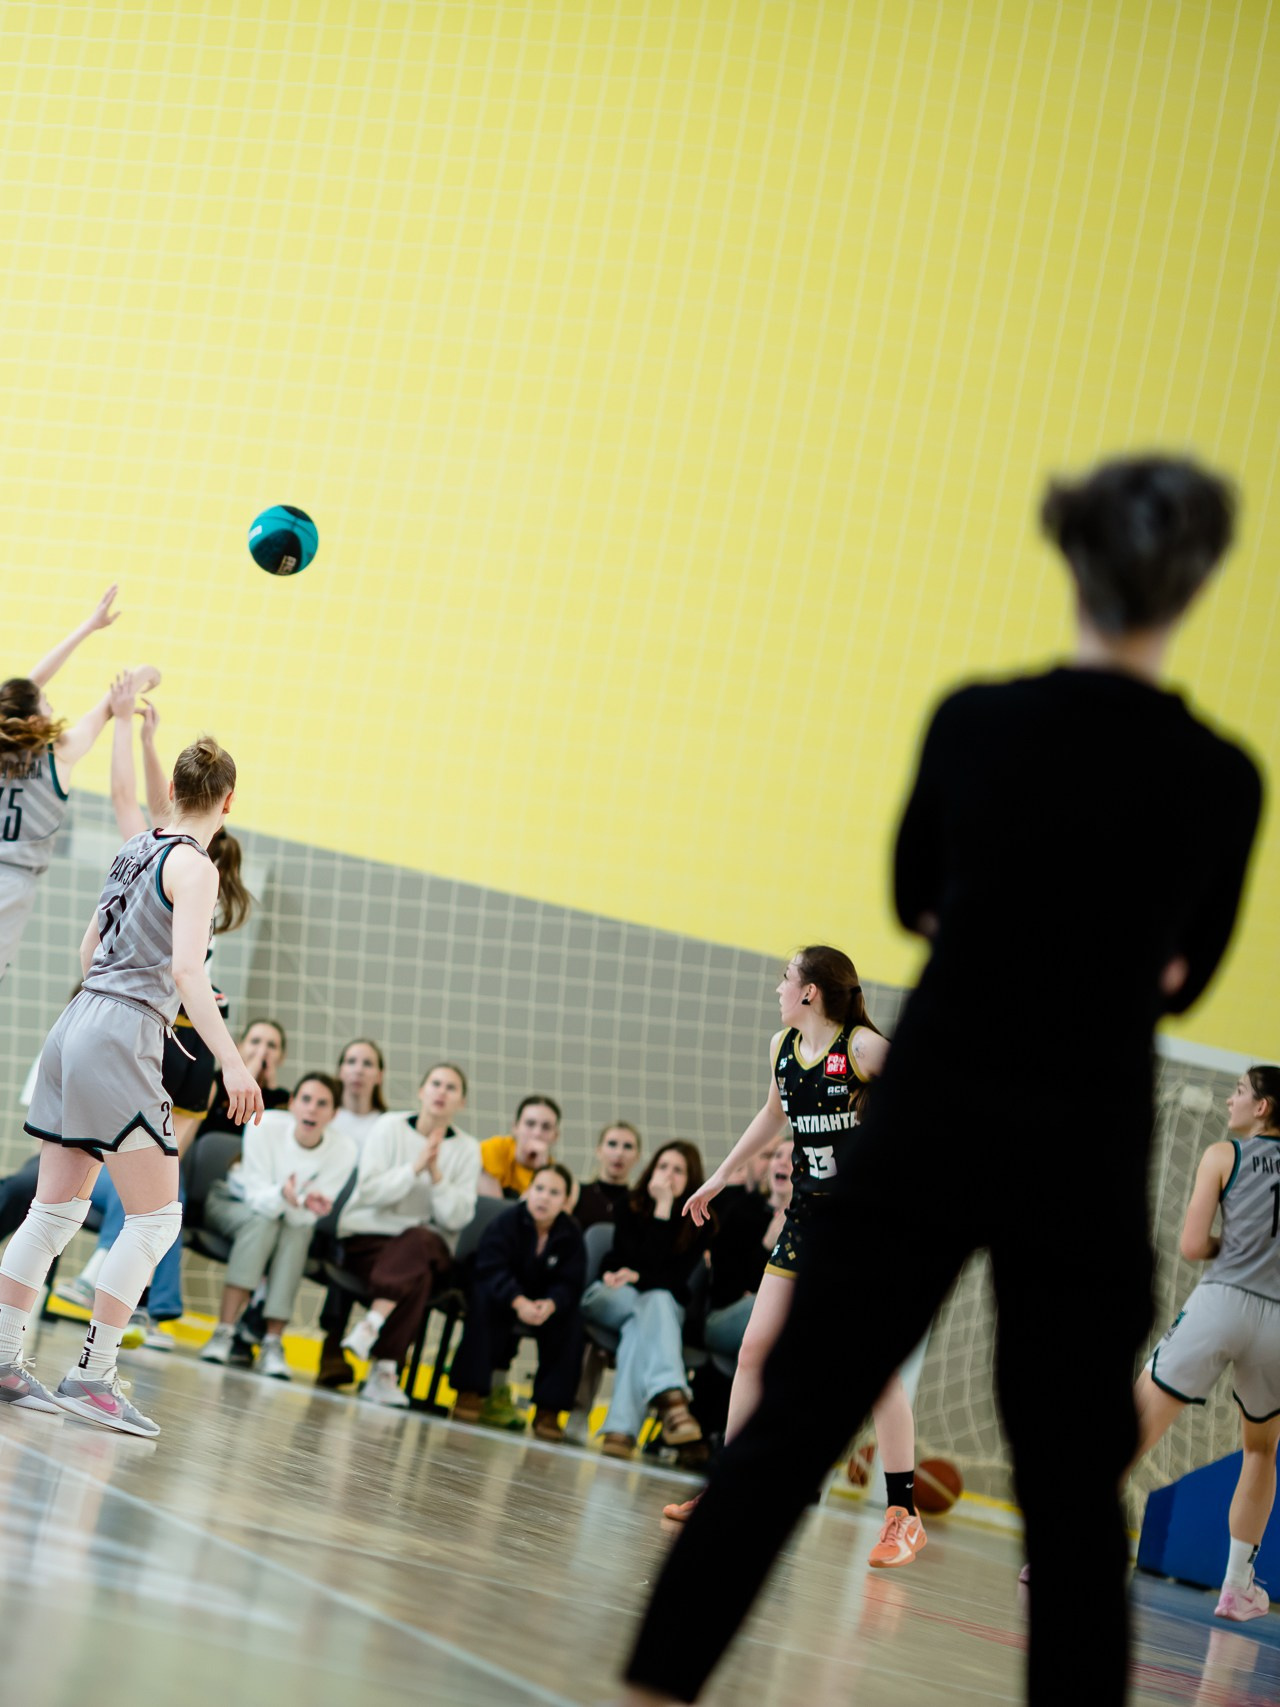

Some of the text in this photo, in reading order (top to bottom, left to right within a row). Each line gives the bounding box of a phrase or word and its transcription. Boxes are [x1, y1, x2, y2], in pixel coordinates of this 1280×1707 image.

[827, 1054, 845, 1064] FON
[827, 1063, 846, 1073] BET
[802, 1145, 838, 1180] 33
